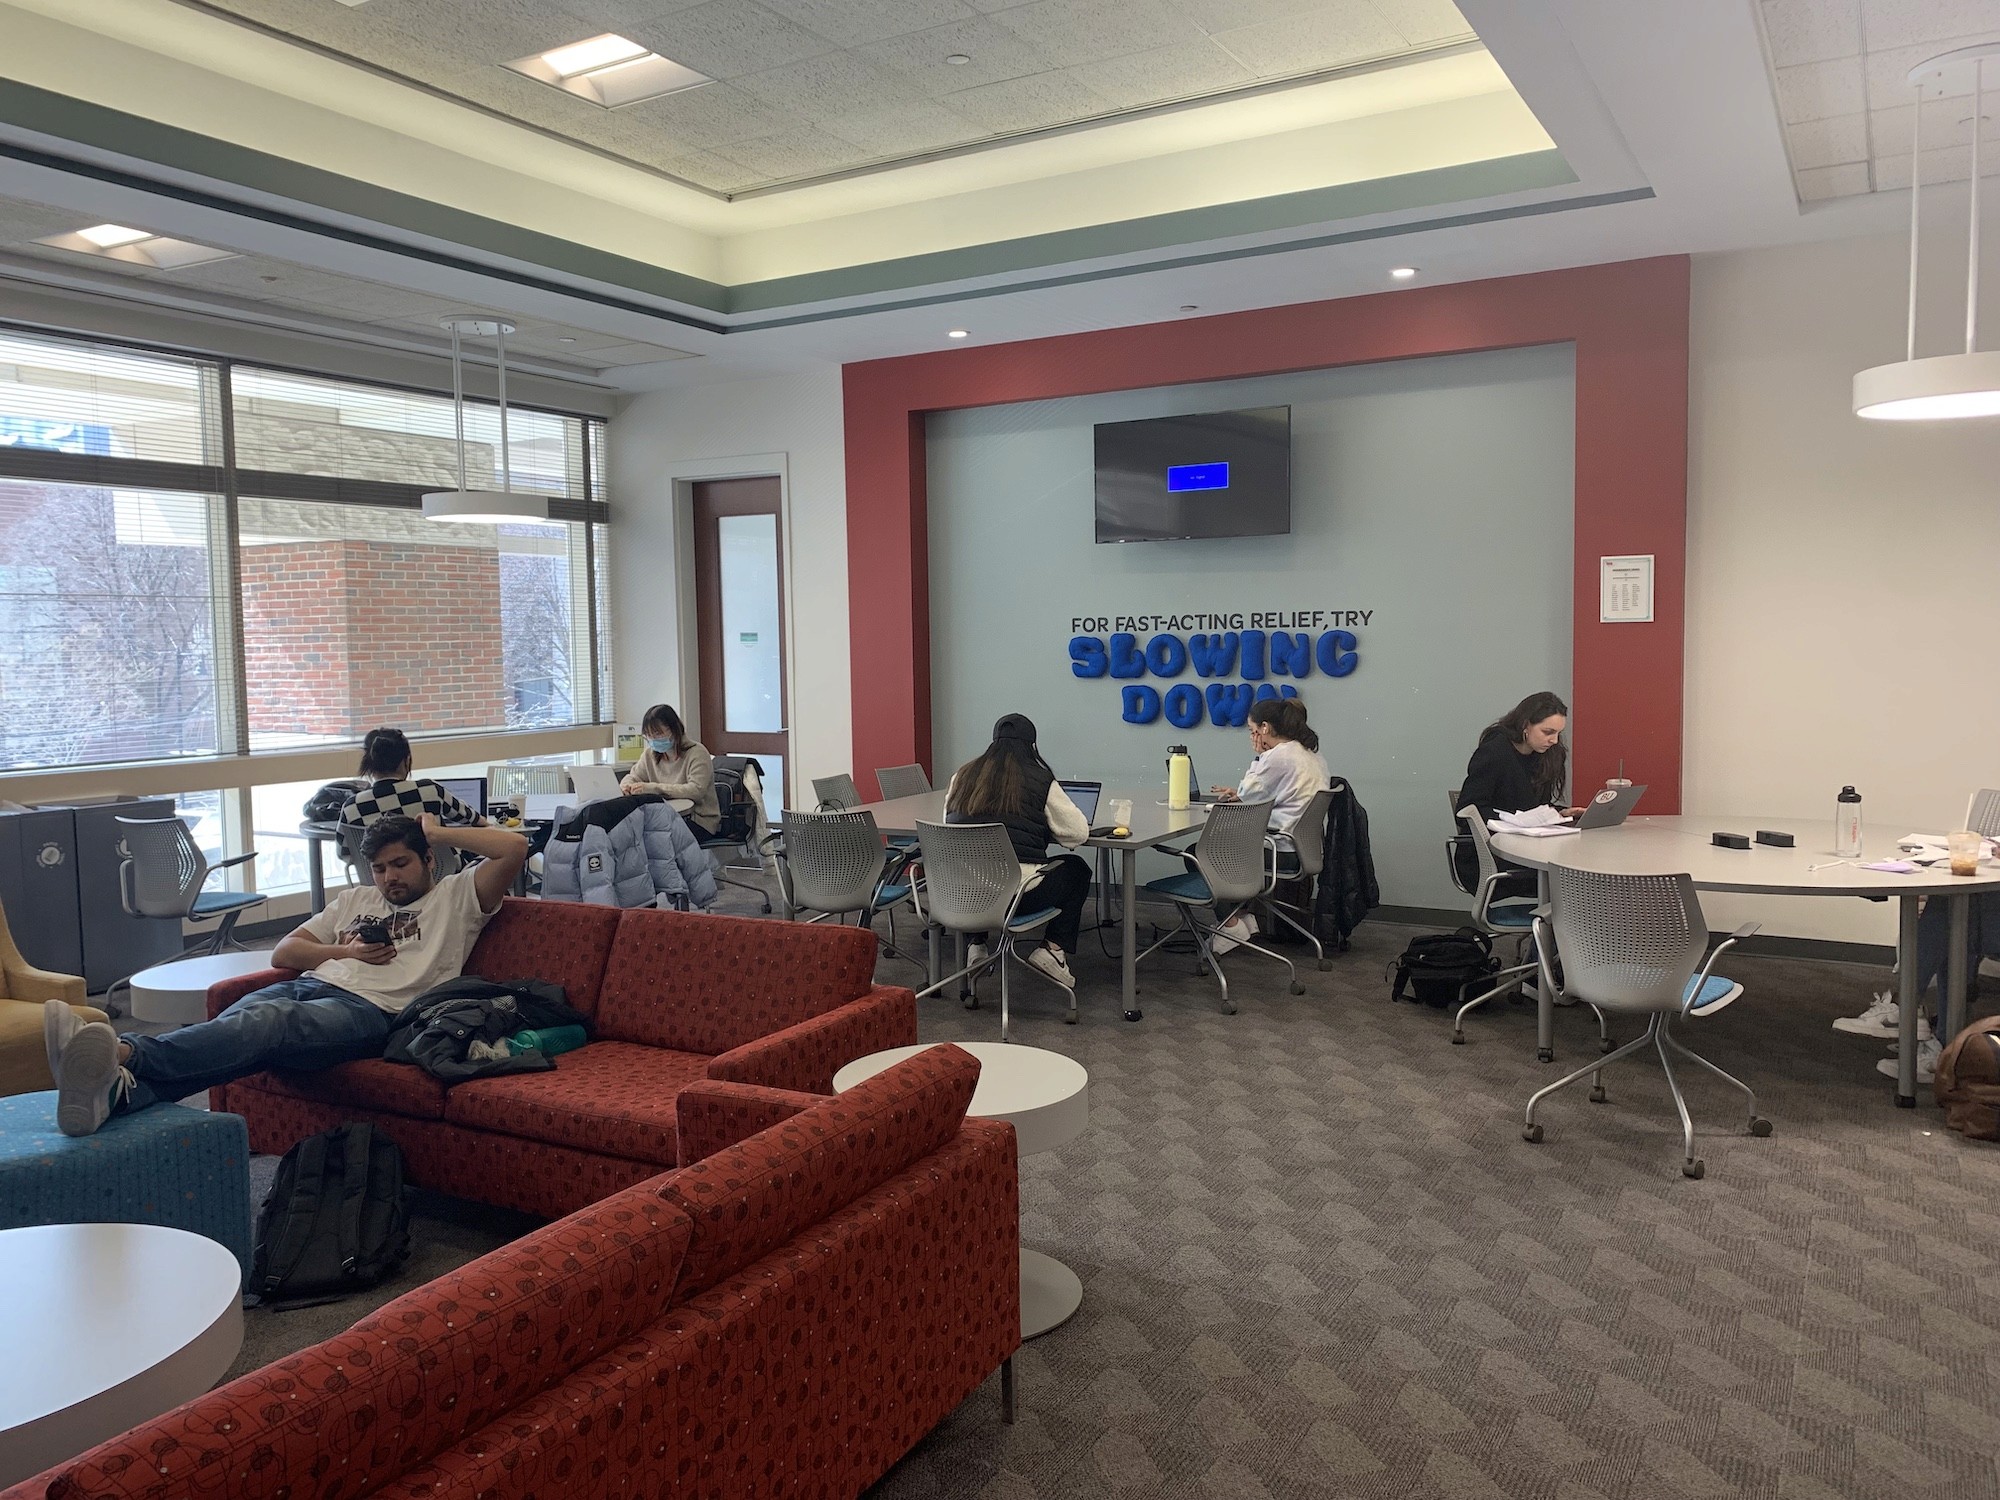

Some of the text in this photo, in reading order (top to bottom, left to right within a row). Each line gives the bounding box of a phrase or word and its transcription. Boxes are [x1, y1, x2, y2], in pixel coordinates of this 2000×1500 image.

[1071, 609, 1374, 633] FOR FAST-ACTING RELIEF, TRY
[1068, 629, 1358, 681] SLOWING
